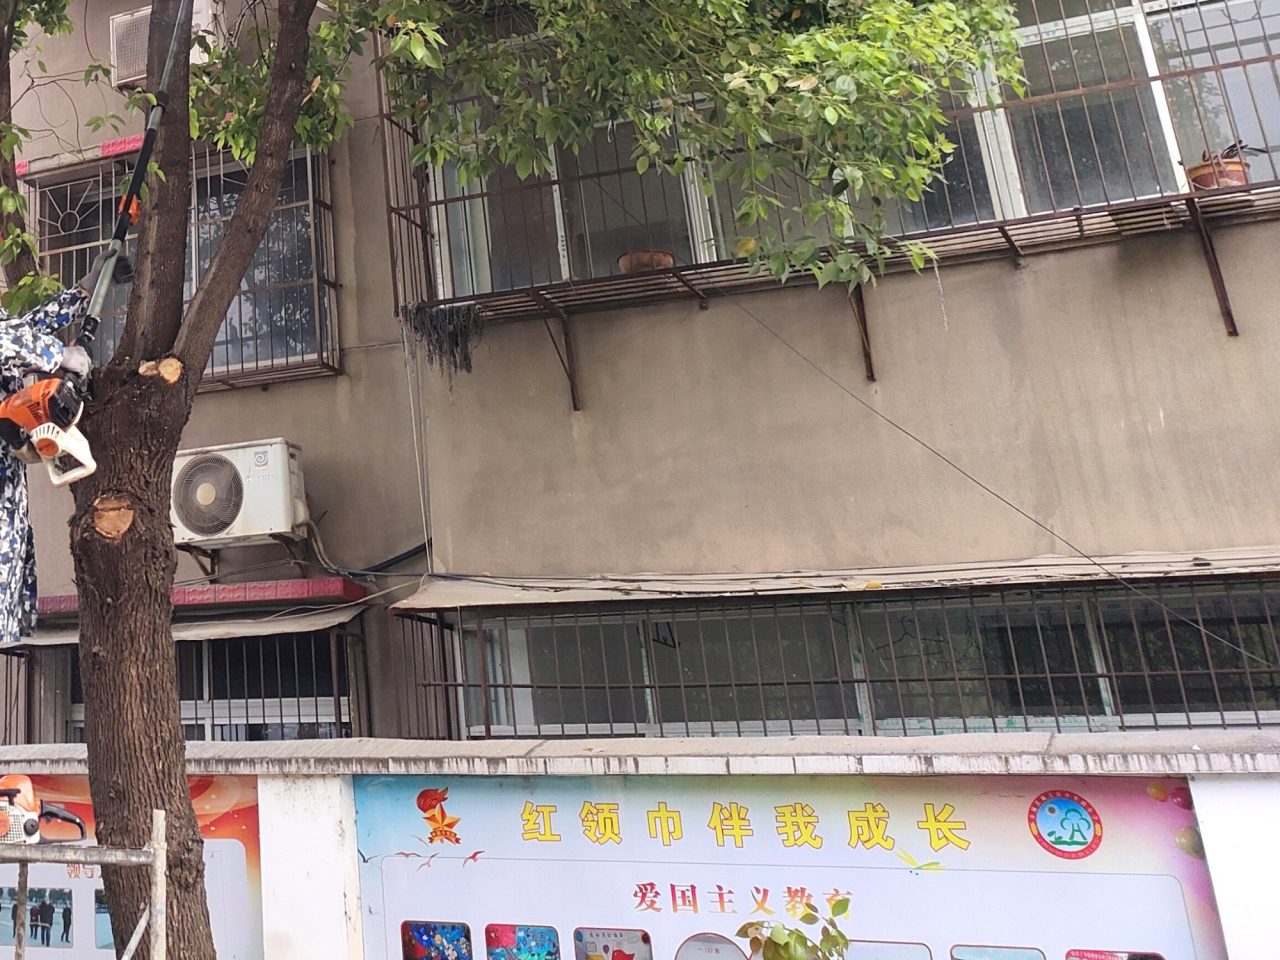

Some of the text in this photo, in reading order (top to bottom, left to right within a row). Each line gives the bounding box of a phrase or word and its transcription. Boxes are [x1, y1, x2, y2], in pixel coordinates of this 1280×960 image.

[520, 800, 971, 852] 红领巾伴我成长
[66, 863, 101, 879] 领导
